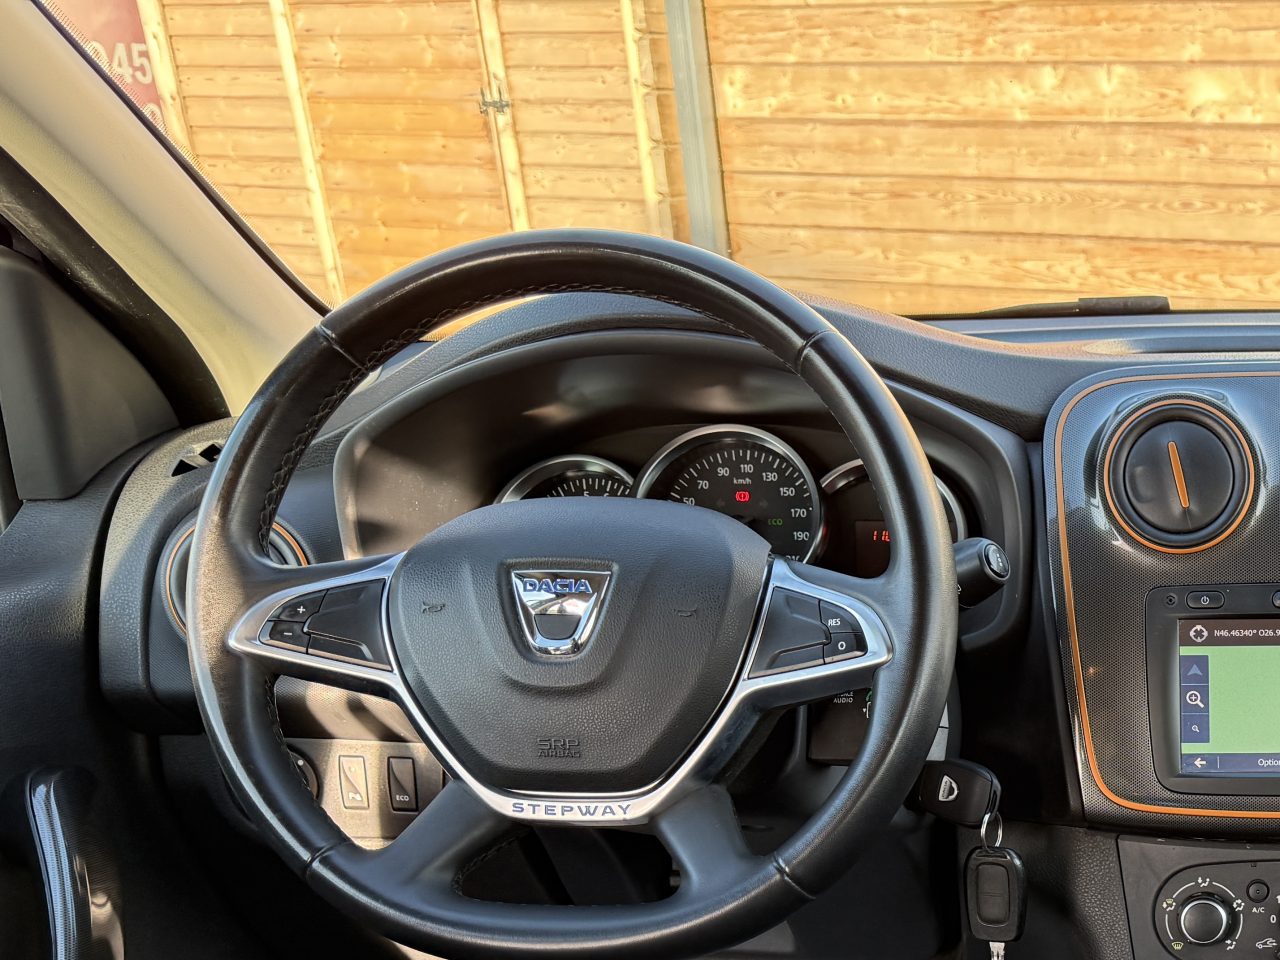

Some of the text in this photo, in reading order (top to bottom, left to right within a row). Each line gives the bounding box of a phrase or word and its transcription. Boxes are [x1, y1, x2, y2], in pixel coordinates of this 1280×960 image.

[717, 467, 730, 476] 90
[740, 464, 753, 473] 110
[733, 477, 752, 485] km/h
[762, 472, 778, 482] 130
[697, 480, 709, 490] 70
[779, 487, 795, 497] 150
[790, 508, 807, 518] 170
[793, 531, 810, 541] 190
[522, 578, 593, 593] DACIA
[828, 617, 841, 627] RES
[536, 738, 581, 750] SRP
[537, 750, 581, 758] AIRBAG
[511, 802, 632, 817] STEPWAY
[1275, 895, 1280, 904] 1
